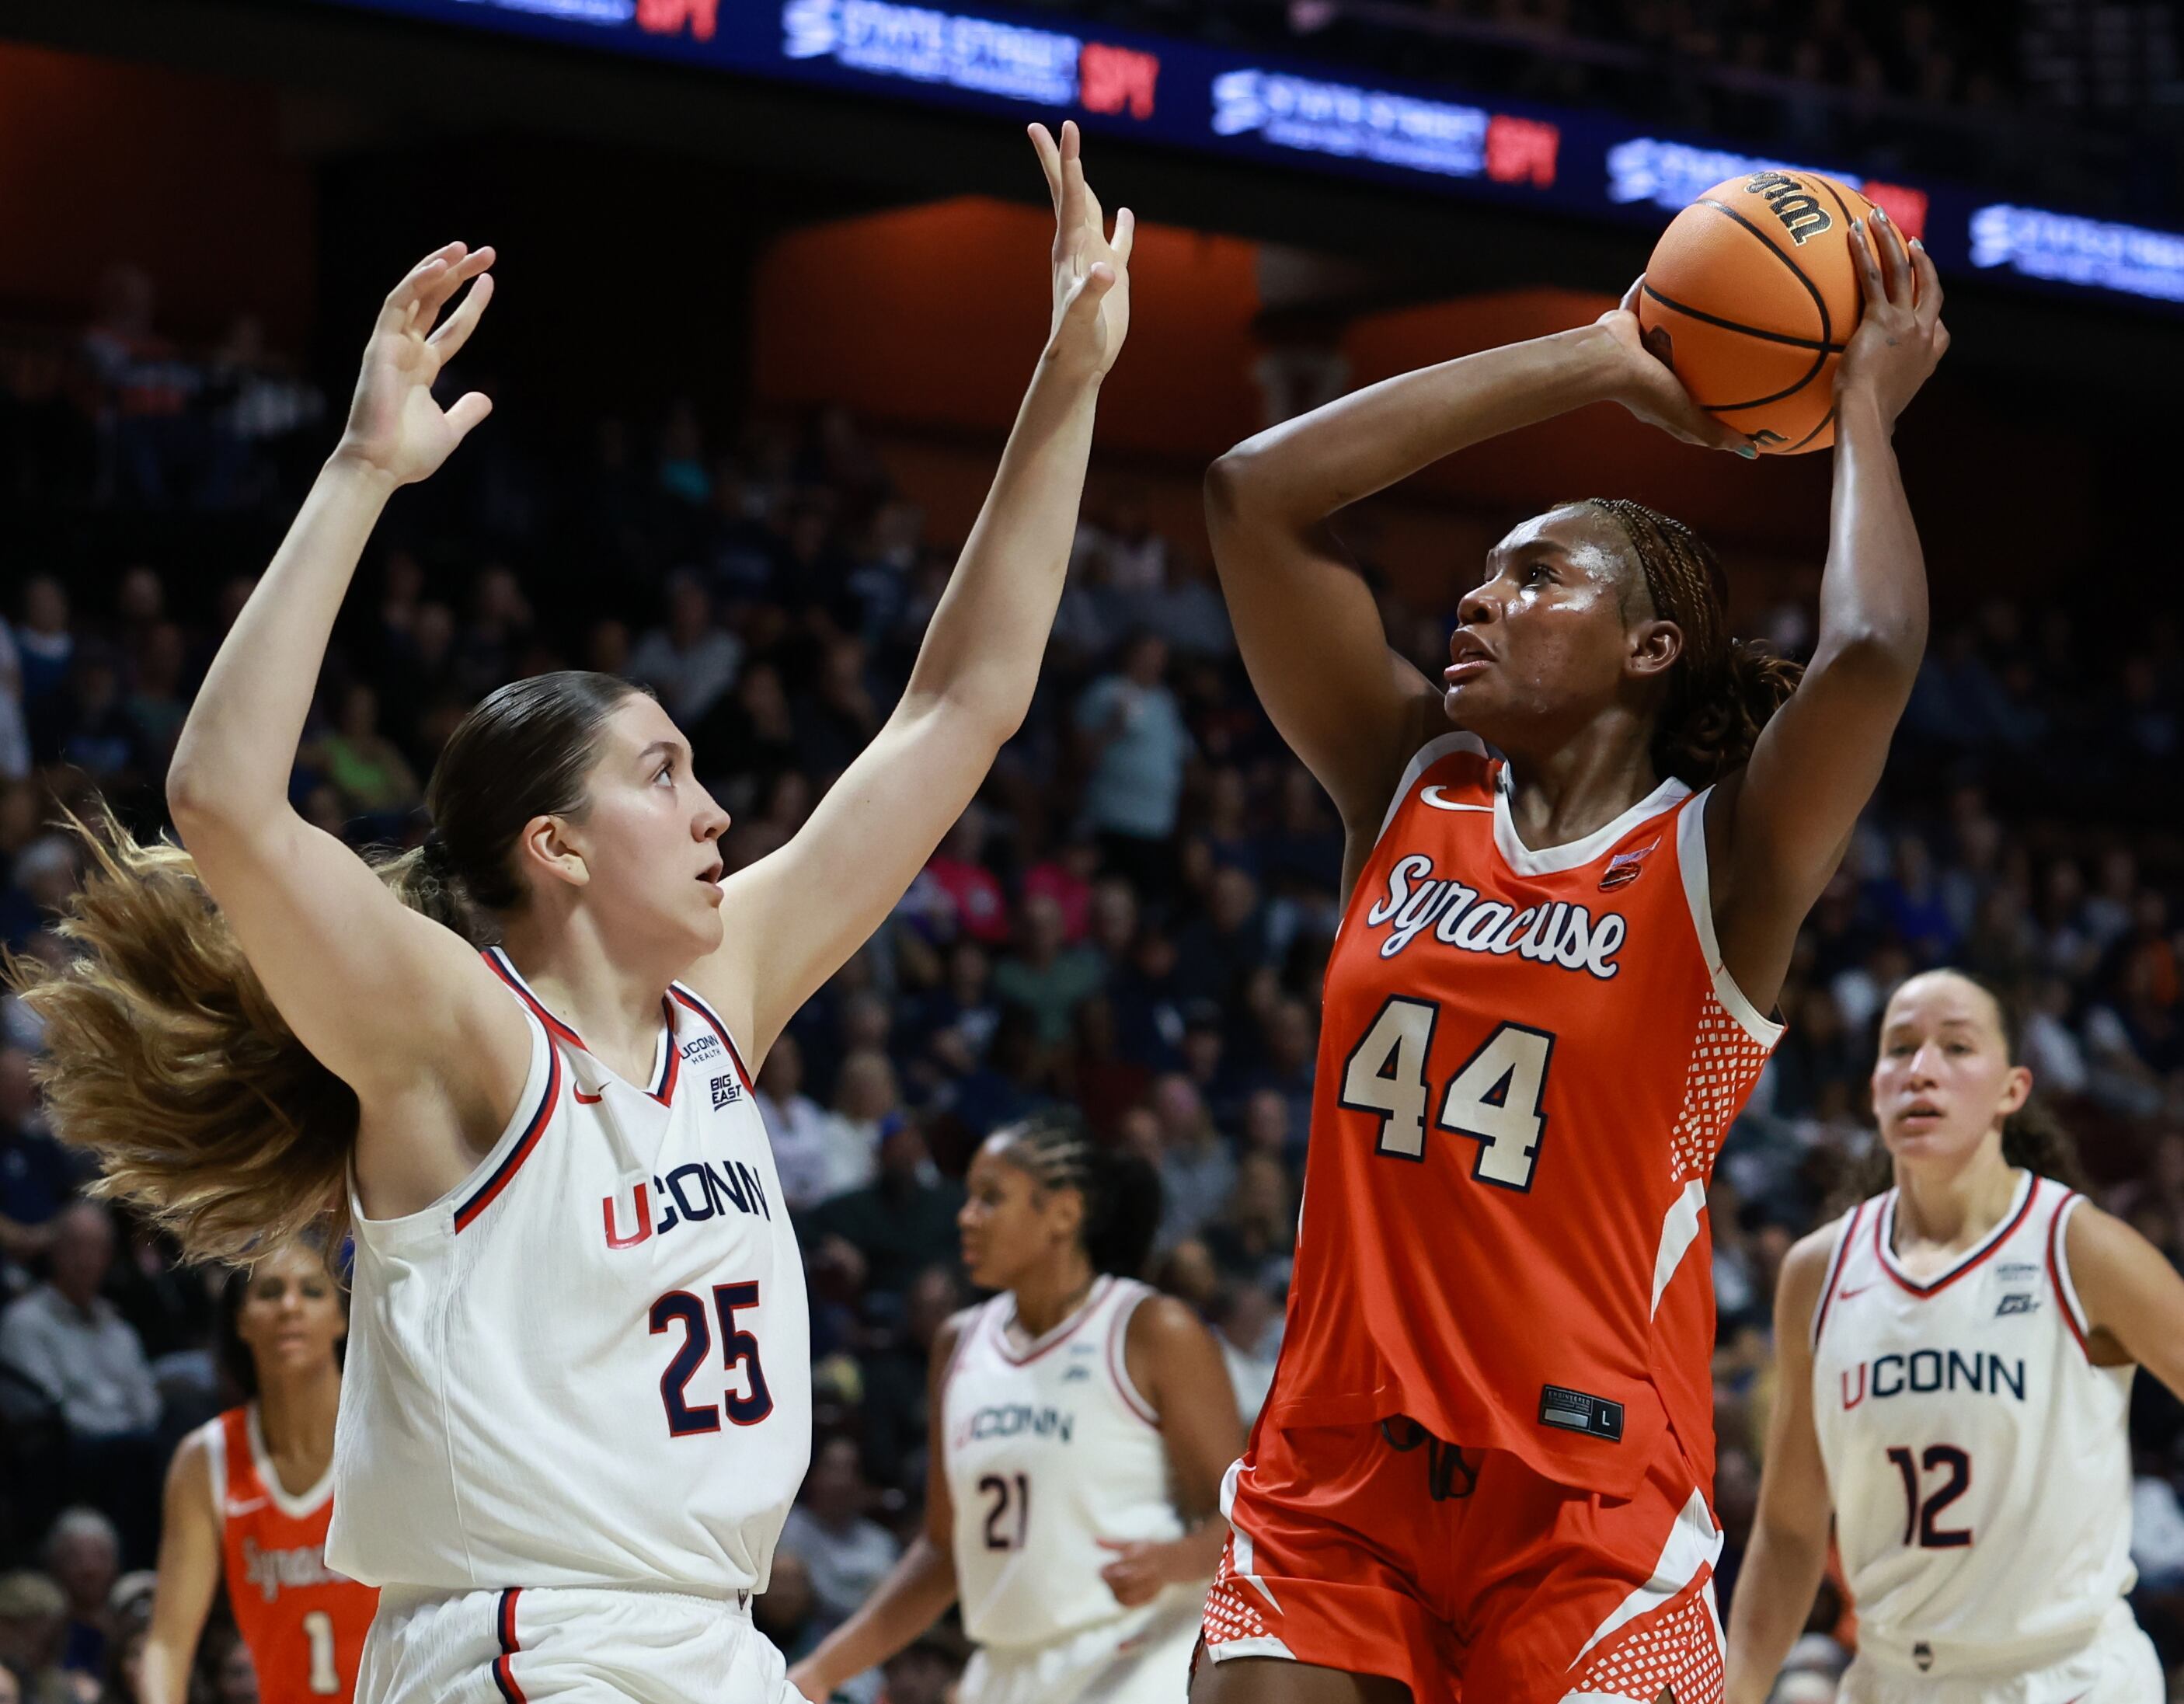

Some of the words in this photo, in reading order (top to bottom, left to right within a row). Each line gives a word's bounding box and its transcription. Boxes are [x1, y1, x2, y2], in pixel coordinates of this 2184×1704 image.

[1367, 854, 1626, 979] Syracuse
[711, 1074, 732, 1092] BIG
[712, 1084, 742, 1105] EAST
[1337, 993, 1555, 1194] 44
[602, 1160, 770, 1249] UCONN
[649, 1280, 774, 1437] 25
[1840, 1349, 2026, 1412] UCONN
[956, 1403, 1074, 1448] UCONN
[1601, 1410, 1611, 1427] L
[977, 1472, 1029, 1549] 21
[1886, 1444, 1973, 1549] 12
[304, 1611, 340, 1695] 1
